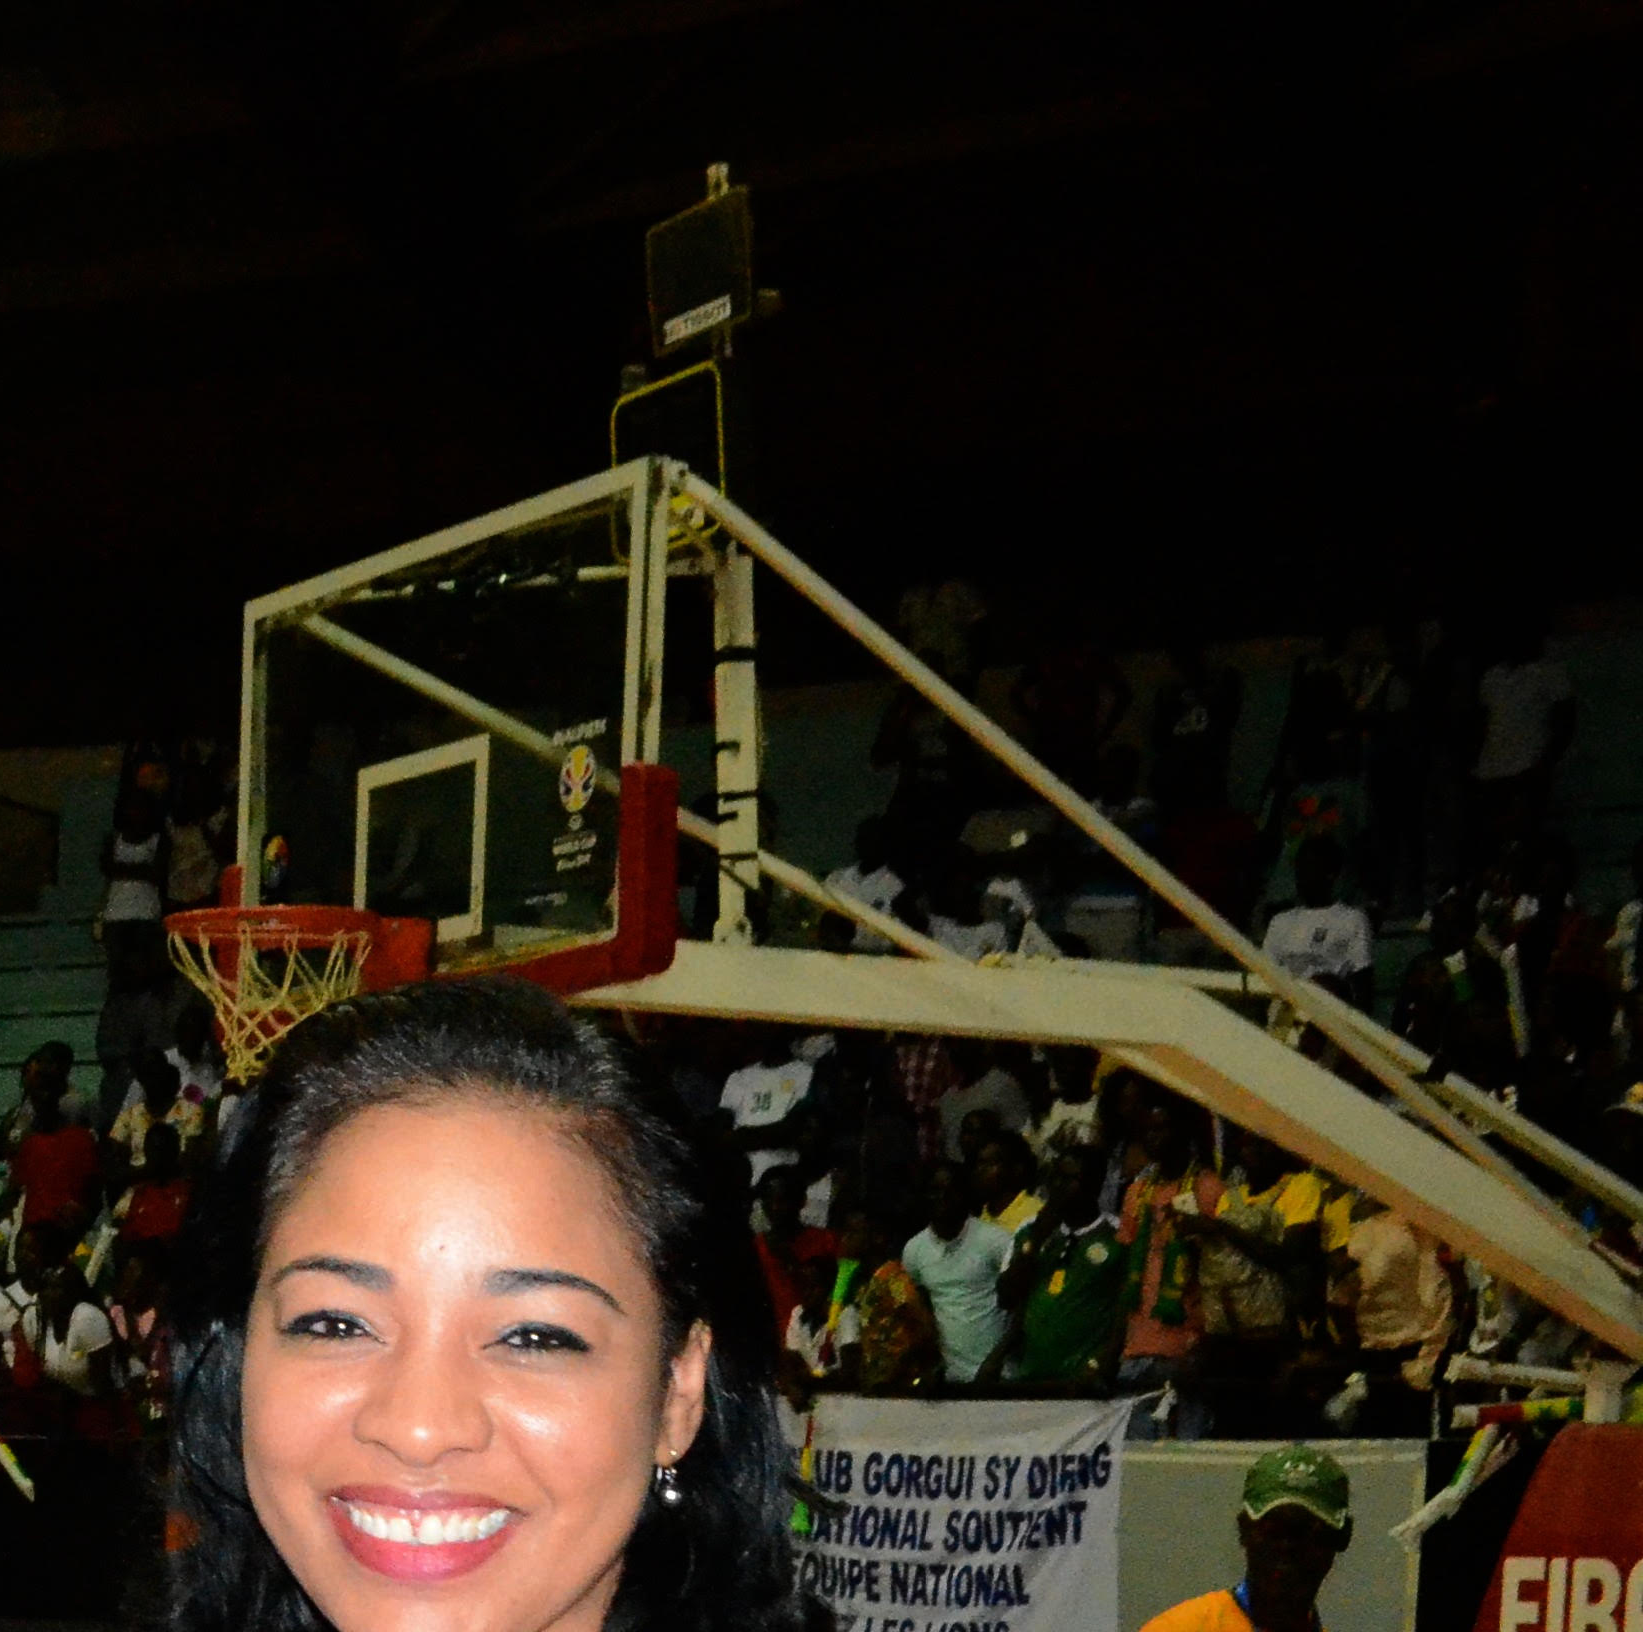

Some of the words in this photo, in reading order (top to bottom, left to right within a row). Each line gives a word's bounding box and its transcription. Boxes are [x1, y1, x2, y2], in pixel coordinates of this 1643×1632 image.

[862, 1452, 976, 1500] GORGUI
[984, 1456, 1022, 1500] SY
[813, 1504, 933, 1551] ATIONAL
[890, 1561, 1031, 1609] NATIONAL
